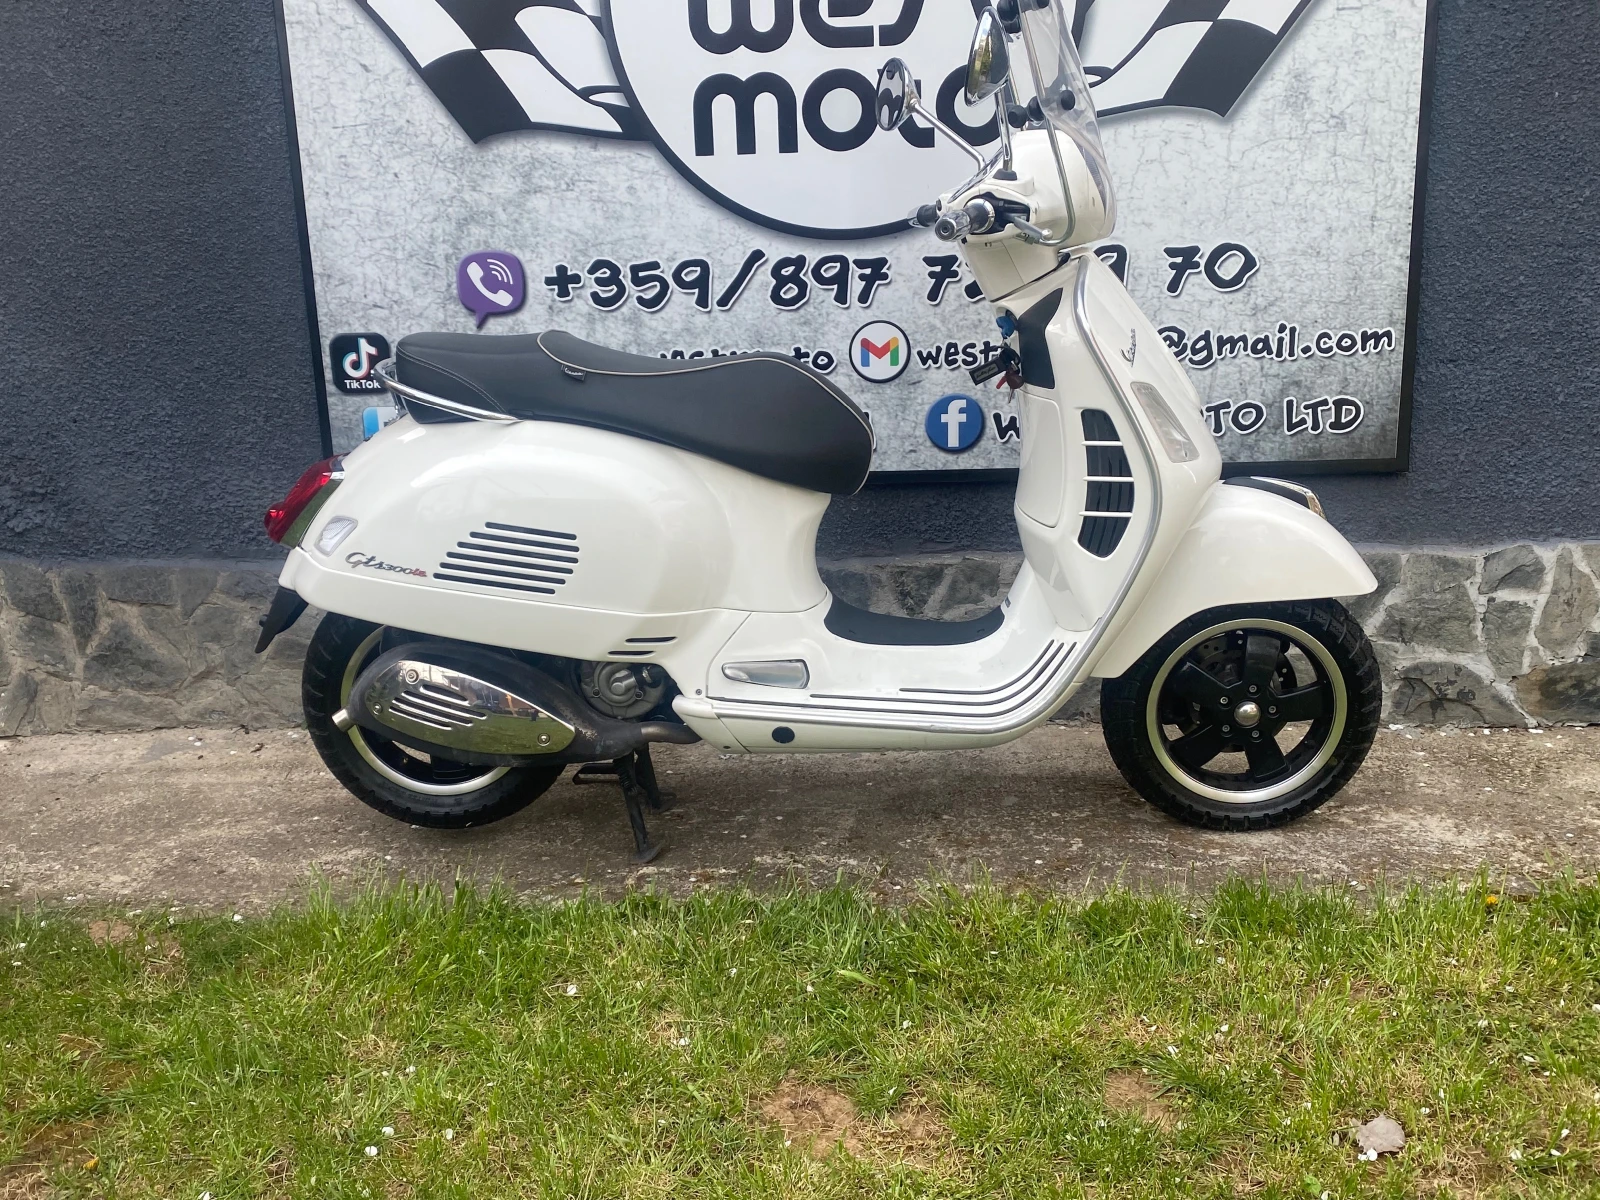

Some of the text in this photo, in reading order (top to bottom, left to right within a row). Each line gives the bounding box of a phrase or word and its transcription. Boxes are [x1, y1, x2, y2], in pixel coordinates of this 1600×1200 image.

[544, 248, 890, 310] +359/897
[1163, 242, 1258, 294] 70
[1156, 322, 1394, 366] @gmail.com
[344, 379, 382, 389] TikTok
[1286, 397, 1362, 434] LTD
